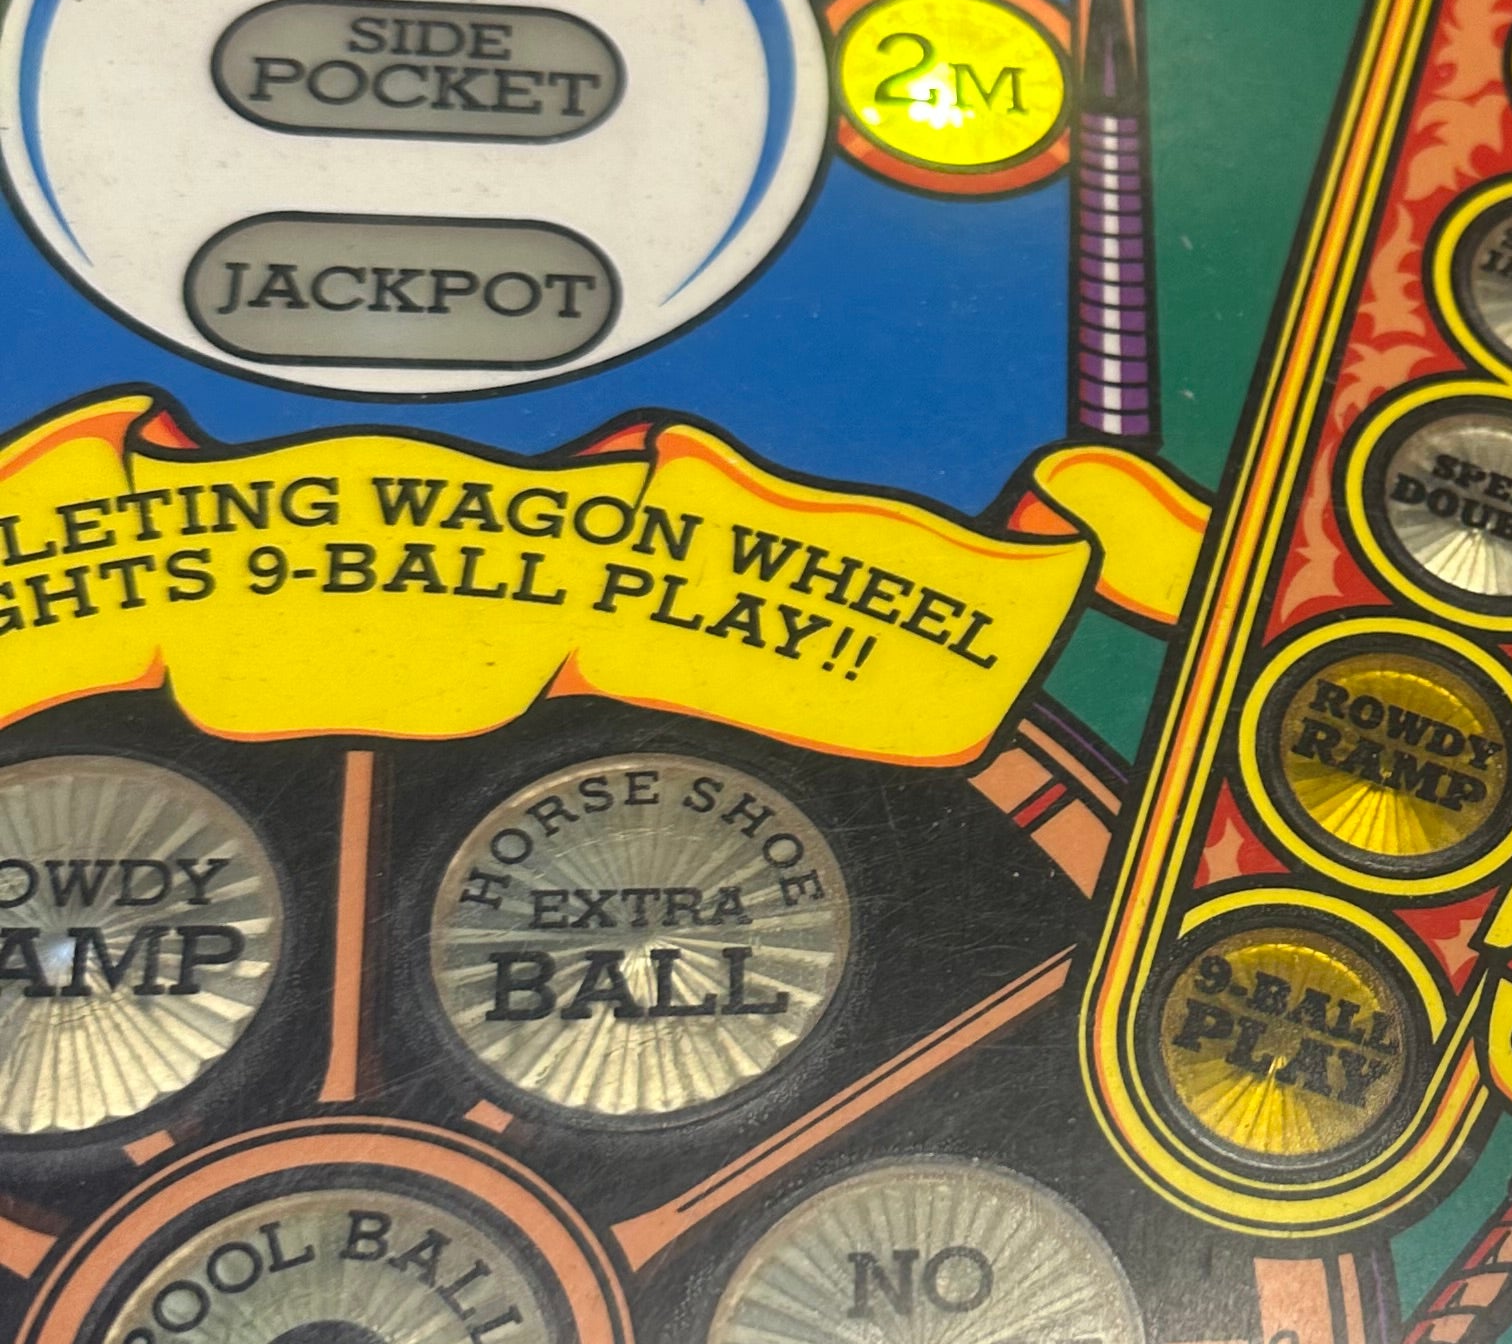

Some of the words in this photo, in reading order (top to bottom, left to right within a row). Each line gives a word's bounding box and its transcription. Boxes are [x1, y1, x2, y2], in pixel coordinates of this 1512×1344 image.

[349, 16, 512, 60] SIDE
[248, 55, 602, 118] POCKET
[216, 261, 597, 319] JACKPOT
[247, 543, 568, 605] 9-BALL
[592, 562, 879, 681] PLAY!!
[372, 477, 703, 561] WAGON
[729, 524, 999, 670] WHEEL
[1291, 716, 1489, 813] RAMP
[1309, 677, 1503, 771] ROWDY
[459, 770, 661, 911] HORSE
[683, 774, 826, 907] SHOE
[528, 887, 753, 930] EXTRA
[485, 947, 790, 1022] BALL
[1193, 954, 1402, 1053] 9-BALL
[1171, 997, 1389, 1108] PLAY
[846, 1245, 994, 1319] NO
